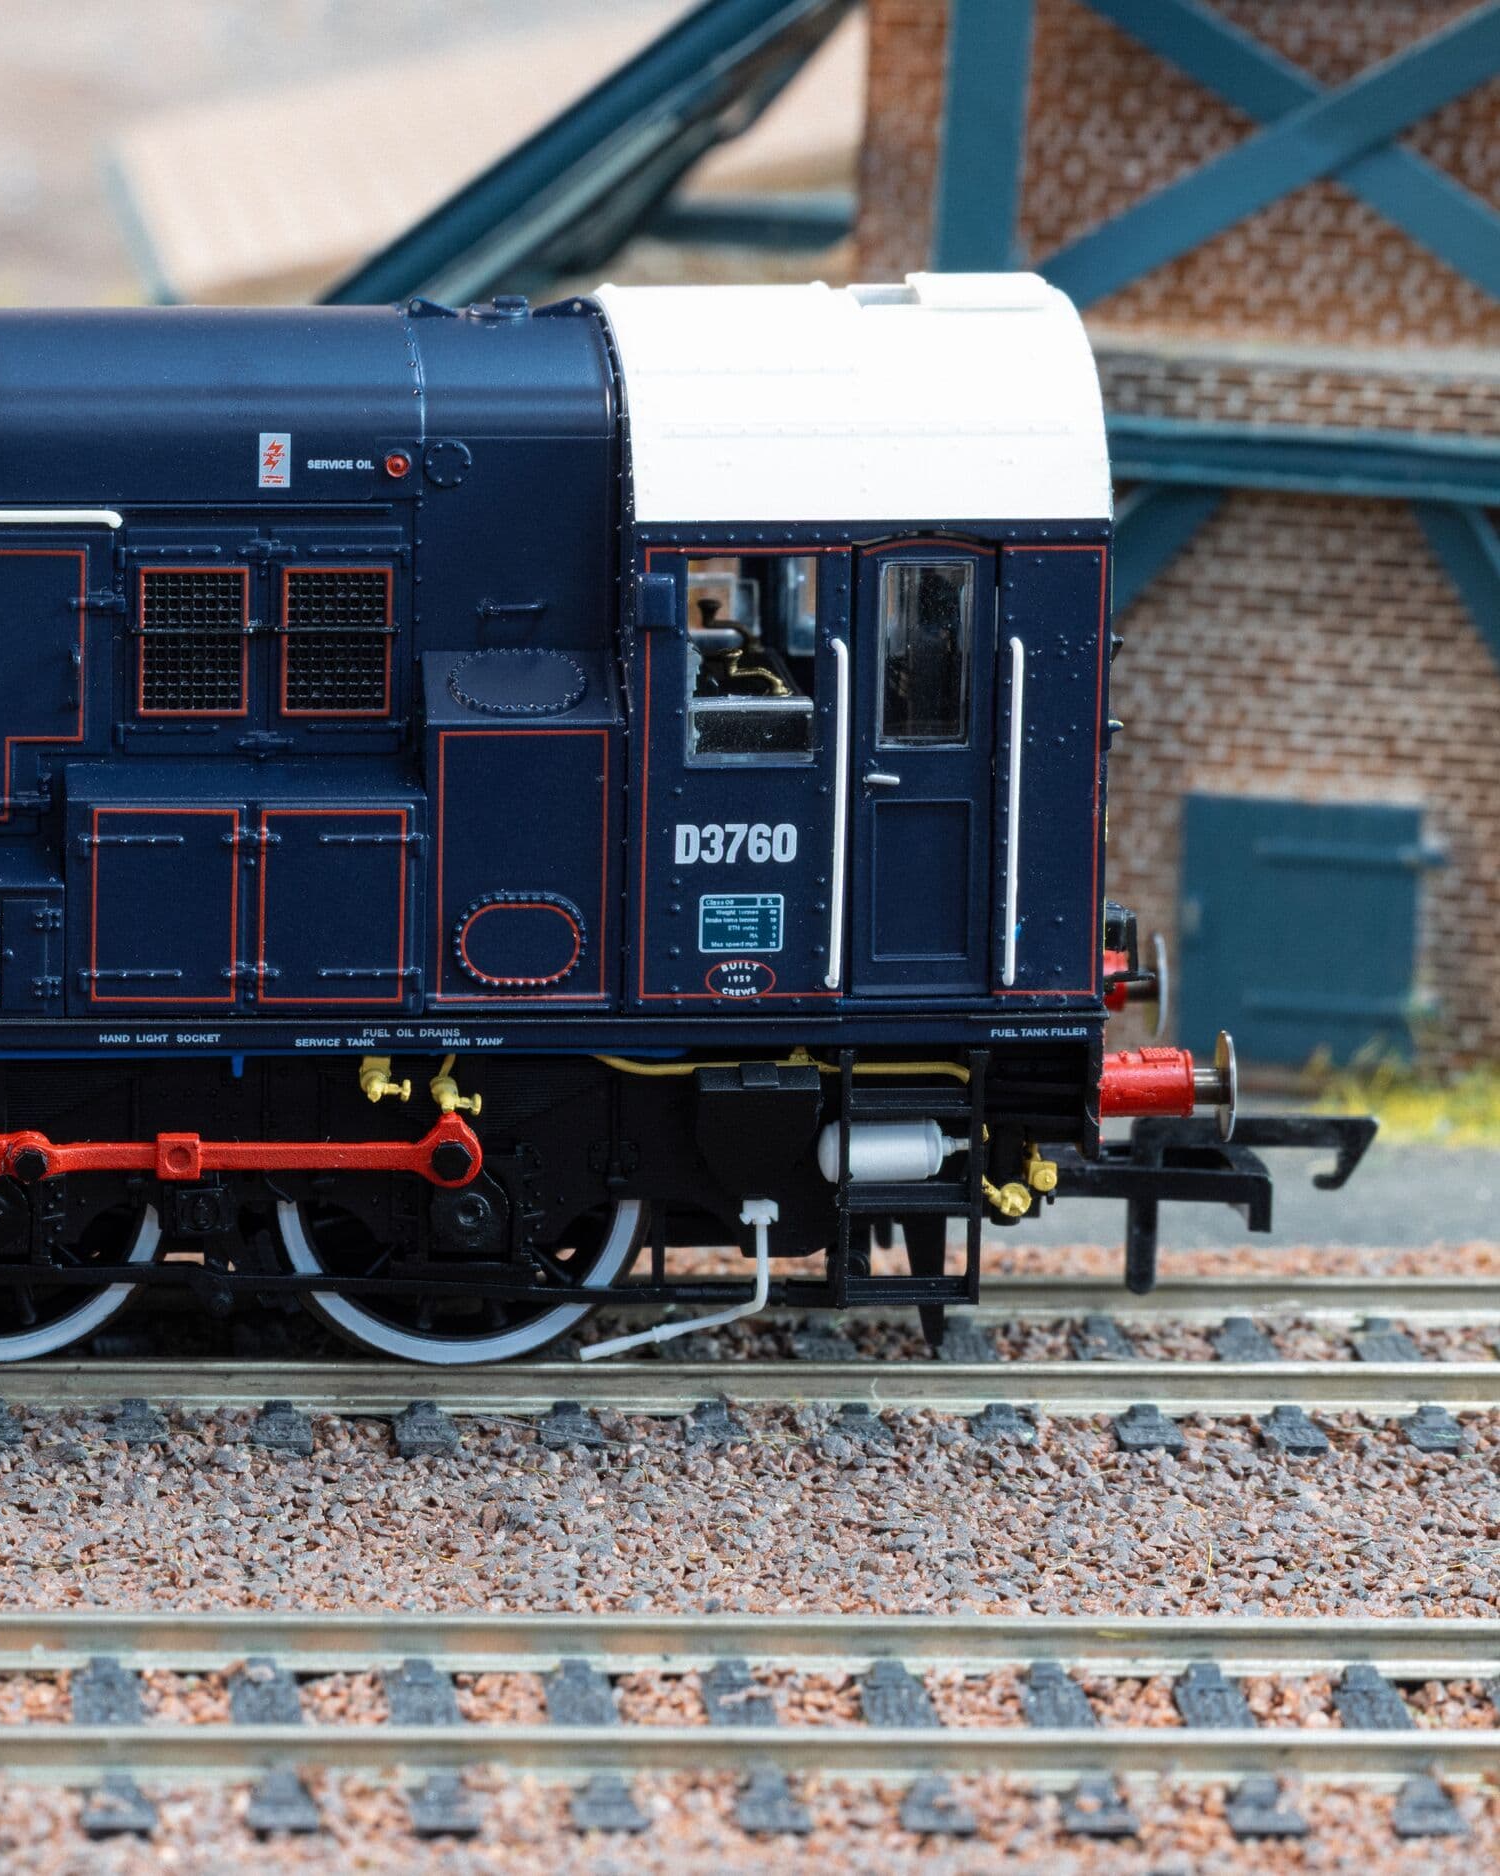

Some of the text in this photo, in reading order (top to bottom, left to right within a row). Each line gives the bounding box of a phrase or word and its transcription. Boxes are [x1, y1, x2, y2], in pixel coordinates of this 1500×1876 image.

[307, 459, 375, 470] SERVICE OIL
[674, 823, 798, 865] D3760
[721, 962, 760, 972] BUILT
[727, 975, 751, 983] 1959
[722, 986, 757, 996] CREWE
[363, 1028, 460, 1038] FUEL OIL DRAINS
[990, 1027, 1087, 1038] FUEL TANK FILLER
[99, 1033, 221, 1043] HAND LIGHT SOCKET
[295, 1038, 375, 1047] SERVICE TANK
[442, 1037, 504, 1047] MAIN TANK
